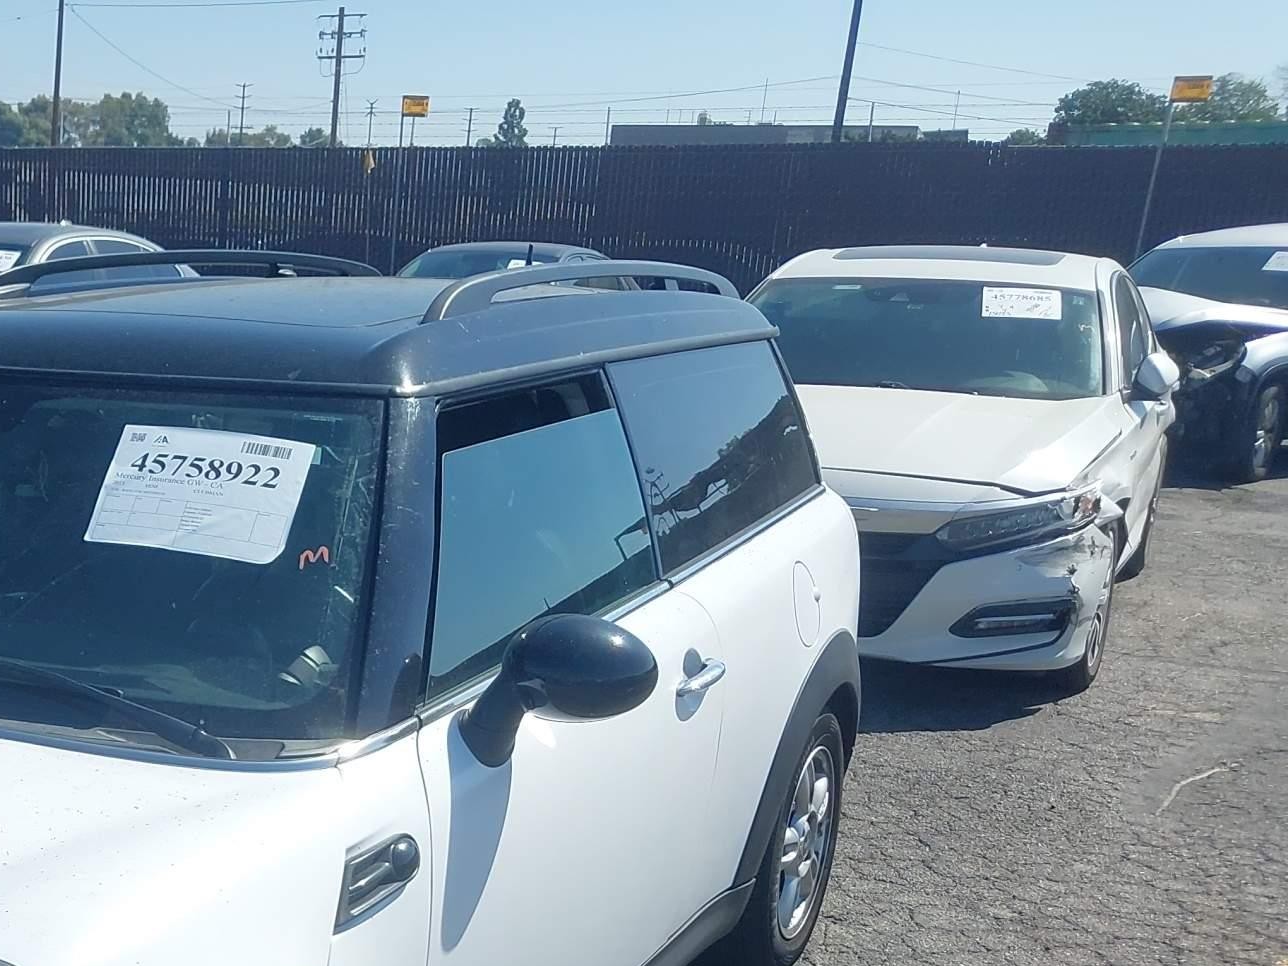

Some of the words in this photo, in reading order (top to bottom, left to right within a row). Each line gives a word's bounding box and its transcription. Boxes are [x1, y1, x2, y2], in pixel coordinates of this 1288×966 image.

[114, 472, 148, 482] Mercury
[148, 475, 186, 485] Insurance
[210, 481, 224, 489] CA
[130, 452, 281, 489] 45758922
